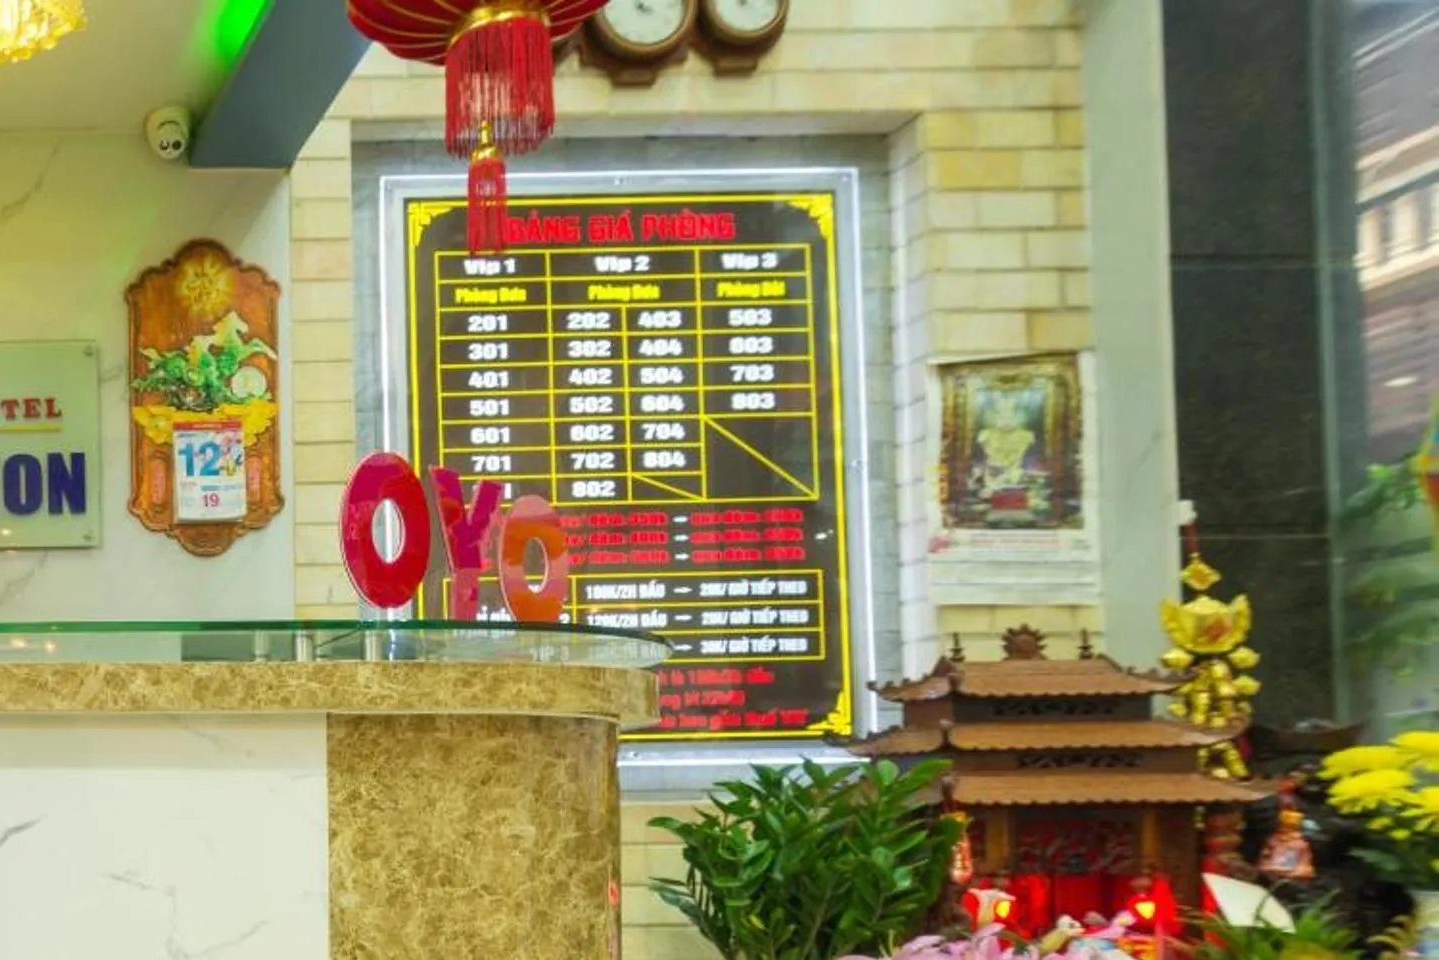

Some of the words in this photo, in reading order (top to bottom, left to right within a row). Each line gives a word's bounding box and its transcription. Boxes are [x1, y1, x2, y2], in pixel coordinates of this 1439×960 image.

[588, 210, 634, 243] GIÁ
[641, 208, 736, 241] PHÒNG
[504, 258, 516, 274] 1
[634, 255, 650, 271] 2
[761, 252, 778, 269] 3
[468, 315, 508, 332] 201
[567, 312, 611, 329] 202
[638, 311, 682, 328] 403
[728, 309, 772, 326] 503
[468, 343, 508, 360] 301
[568, 340, 611, 357] 302
[638, 339, 682, 356] 404
[729, 337, 773, 354] 603
[468, 371, 509, 389] 401
[569, 368, 612, 385] 402
[640, 367, 683, 384] 504
[730, 365, 774, 382] 703
[470, 399, 509, 416] 501
[569, 397, 612, 413] 502
[640, 395, 684, 412] 604
[731, 393, 775, 410] 803
[470, 427, 510, 444] 601
[570, 425, 613, 441] 602
[642, 423, 685, 440] 704
[178, 441, 221, 477] 12
[472, 455, 511, 472] 701
[572, 453, 614, 469] 702
[643, 451, 686, 468] 804
[572, 481, 615, 498] 802
[202, 493, 219, 507] 19
[340, 450, 569, 621] OYO
